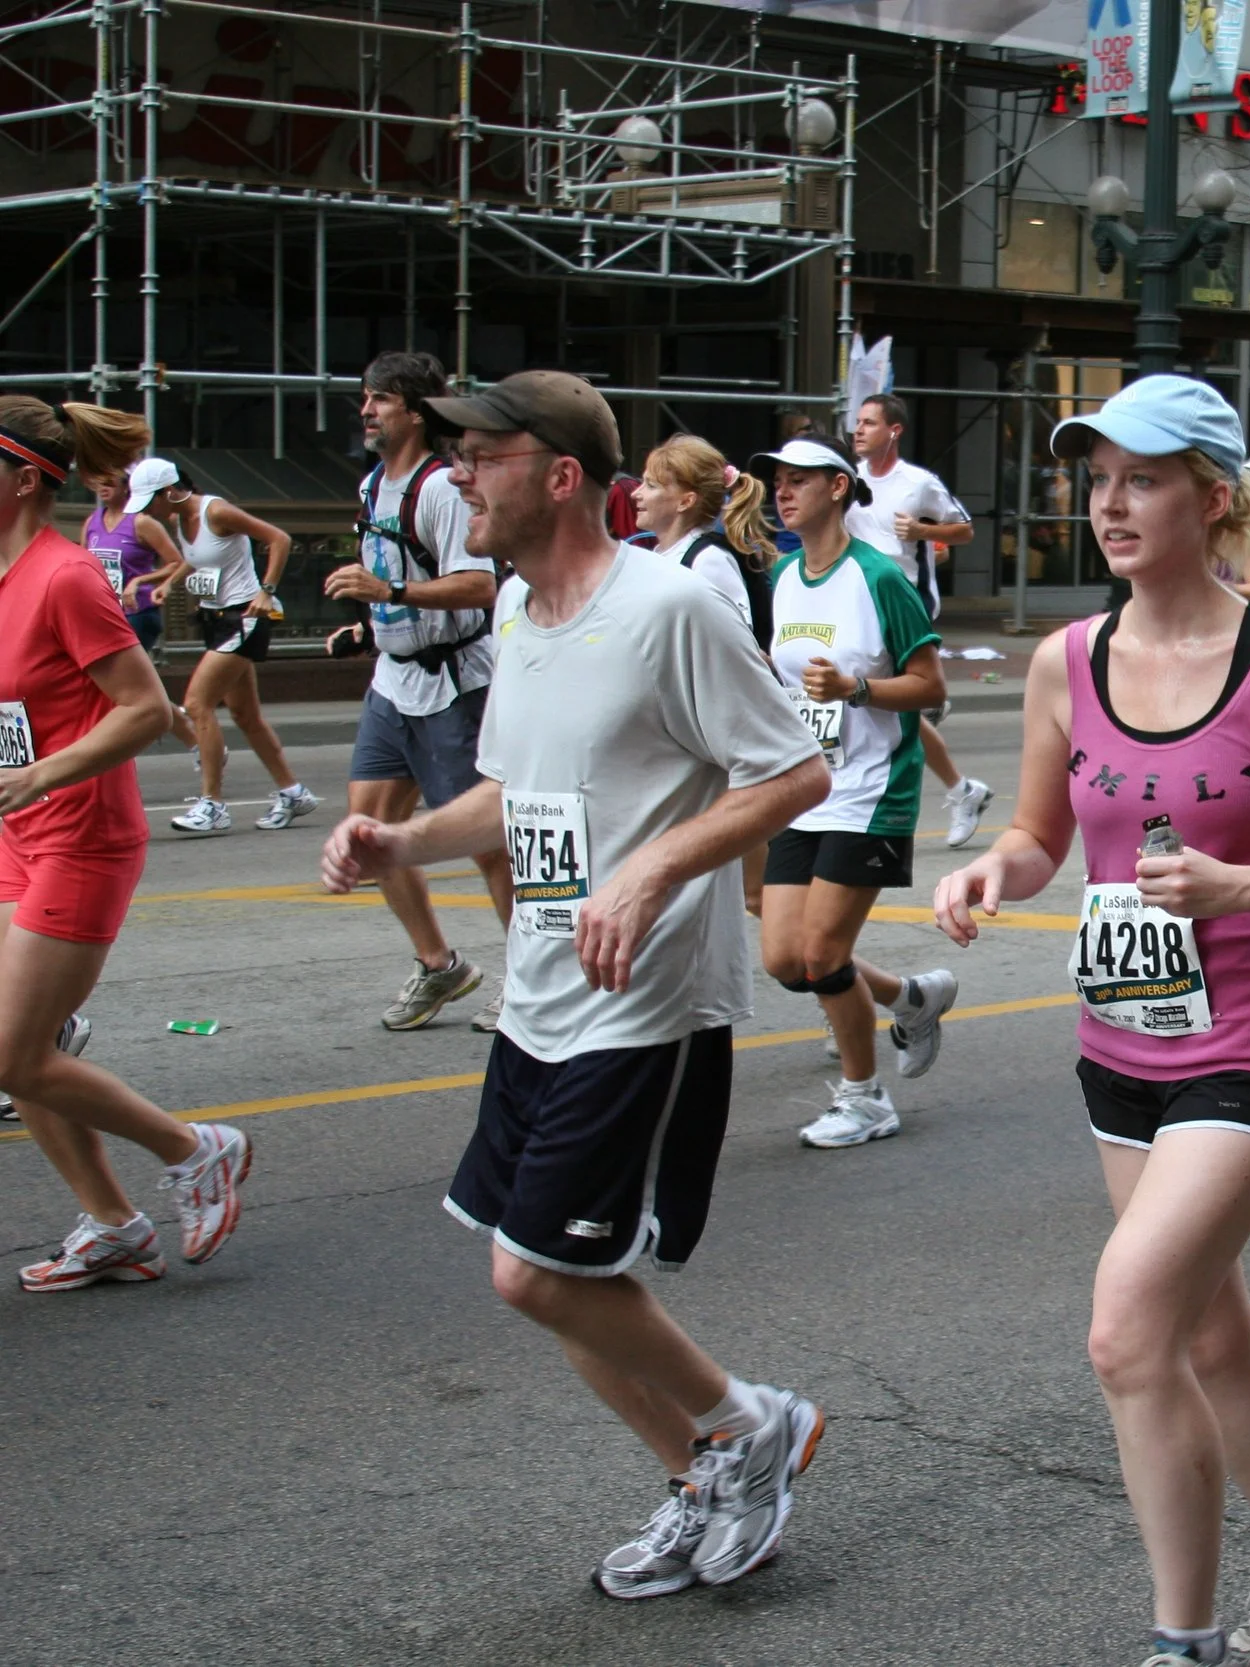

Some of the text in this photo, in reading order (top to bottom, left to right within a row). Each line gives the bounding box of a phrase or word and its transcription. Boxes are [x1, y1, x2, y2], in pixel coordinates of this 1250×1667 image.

[1092, 36, 1133, 57] LOOP
[1098, 54, 1128, 74] THE
[1092, 72, 1134, 94] LOOP
[781, 625, 835, 643] NATURE VALLEY
[515, 802, 565, 817] LaSalle Bank
[1104, 895, 1139, 909] LaSalle
[1077, 921, 1189, 979] 14298
[1094, 978, 1193, 1001] 30th ANNIVERSARY
